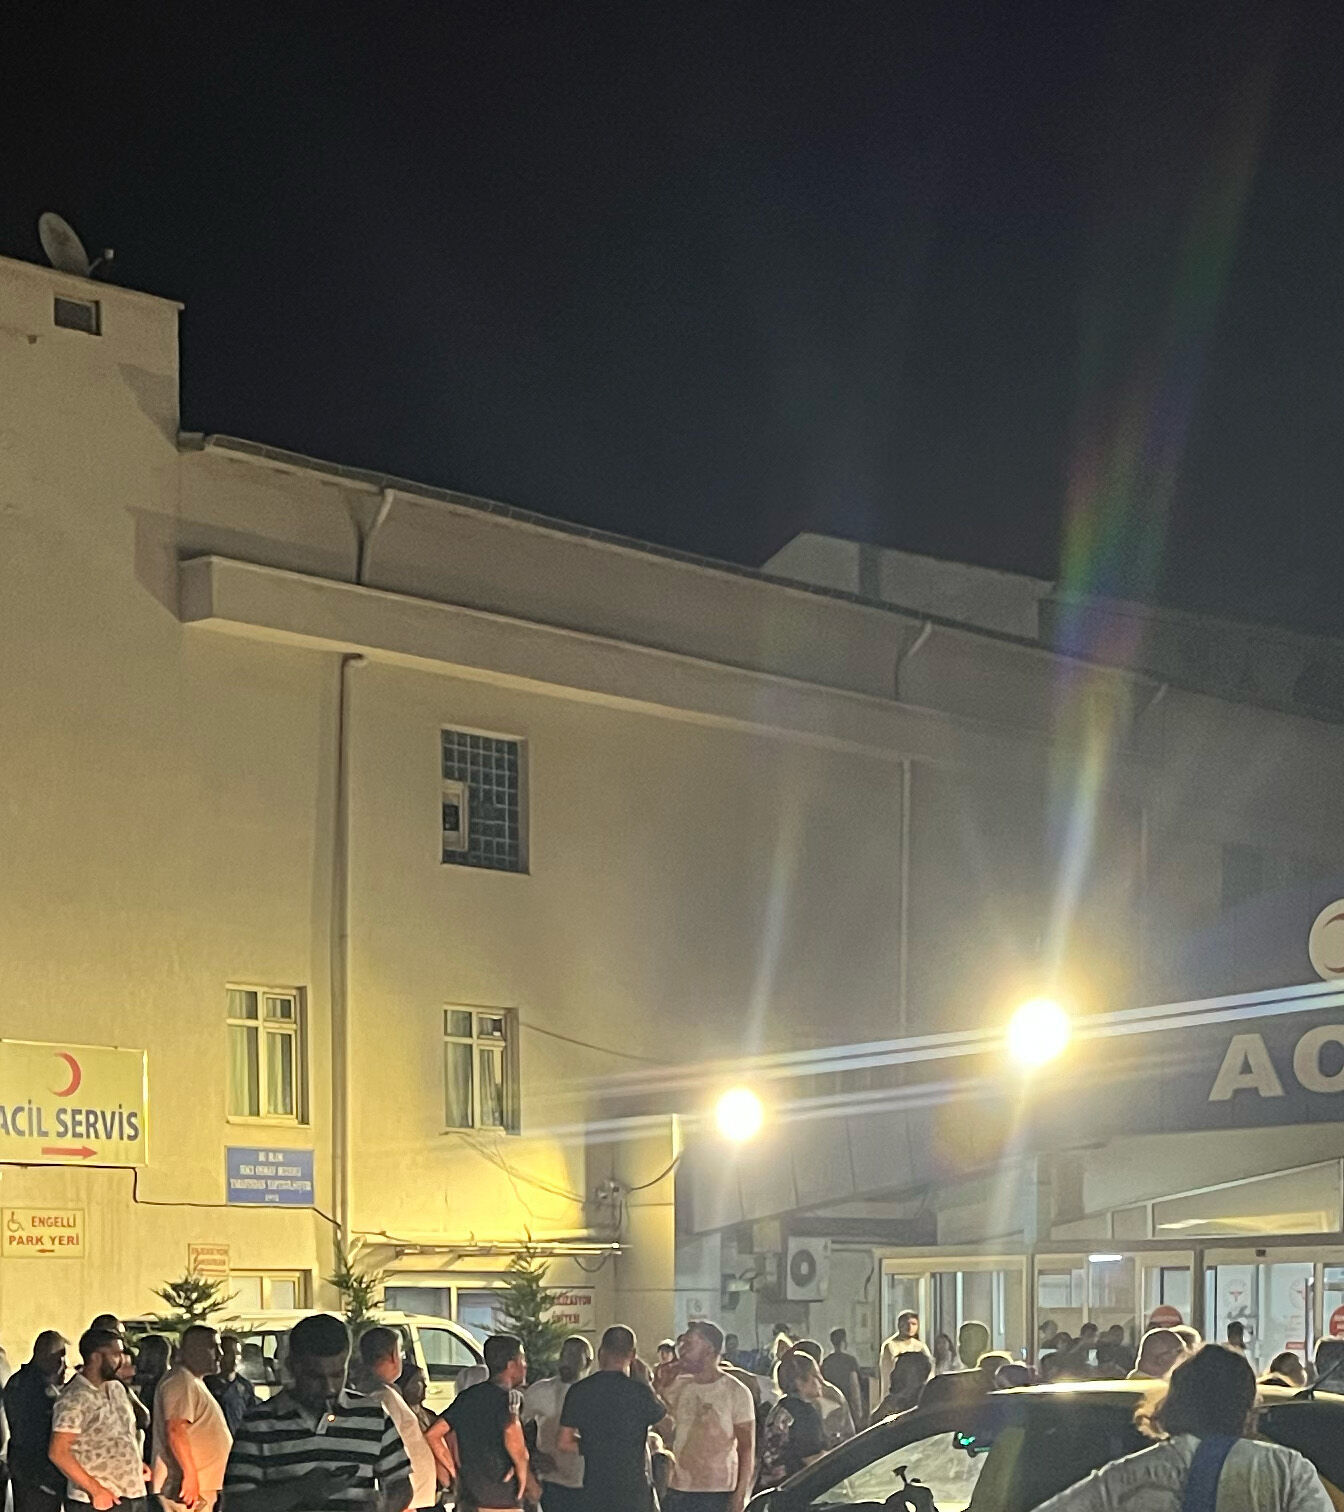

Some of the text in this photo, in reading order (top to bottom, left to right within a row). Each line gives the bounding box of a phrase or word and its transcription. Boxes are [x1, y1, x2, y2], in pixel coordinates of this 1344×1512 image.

[56, 1104, 140, 1141] SERVİS
[31, 1213, 76, 1228] ENGELLİ
[9, 1233, 79, 1245] PARK YERİ
